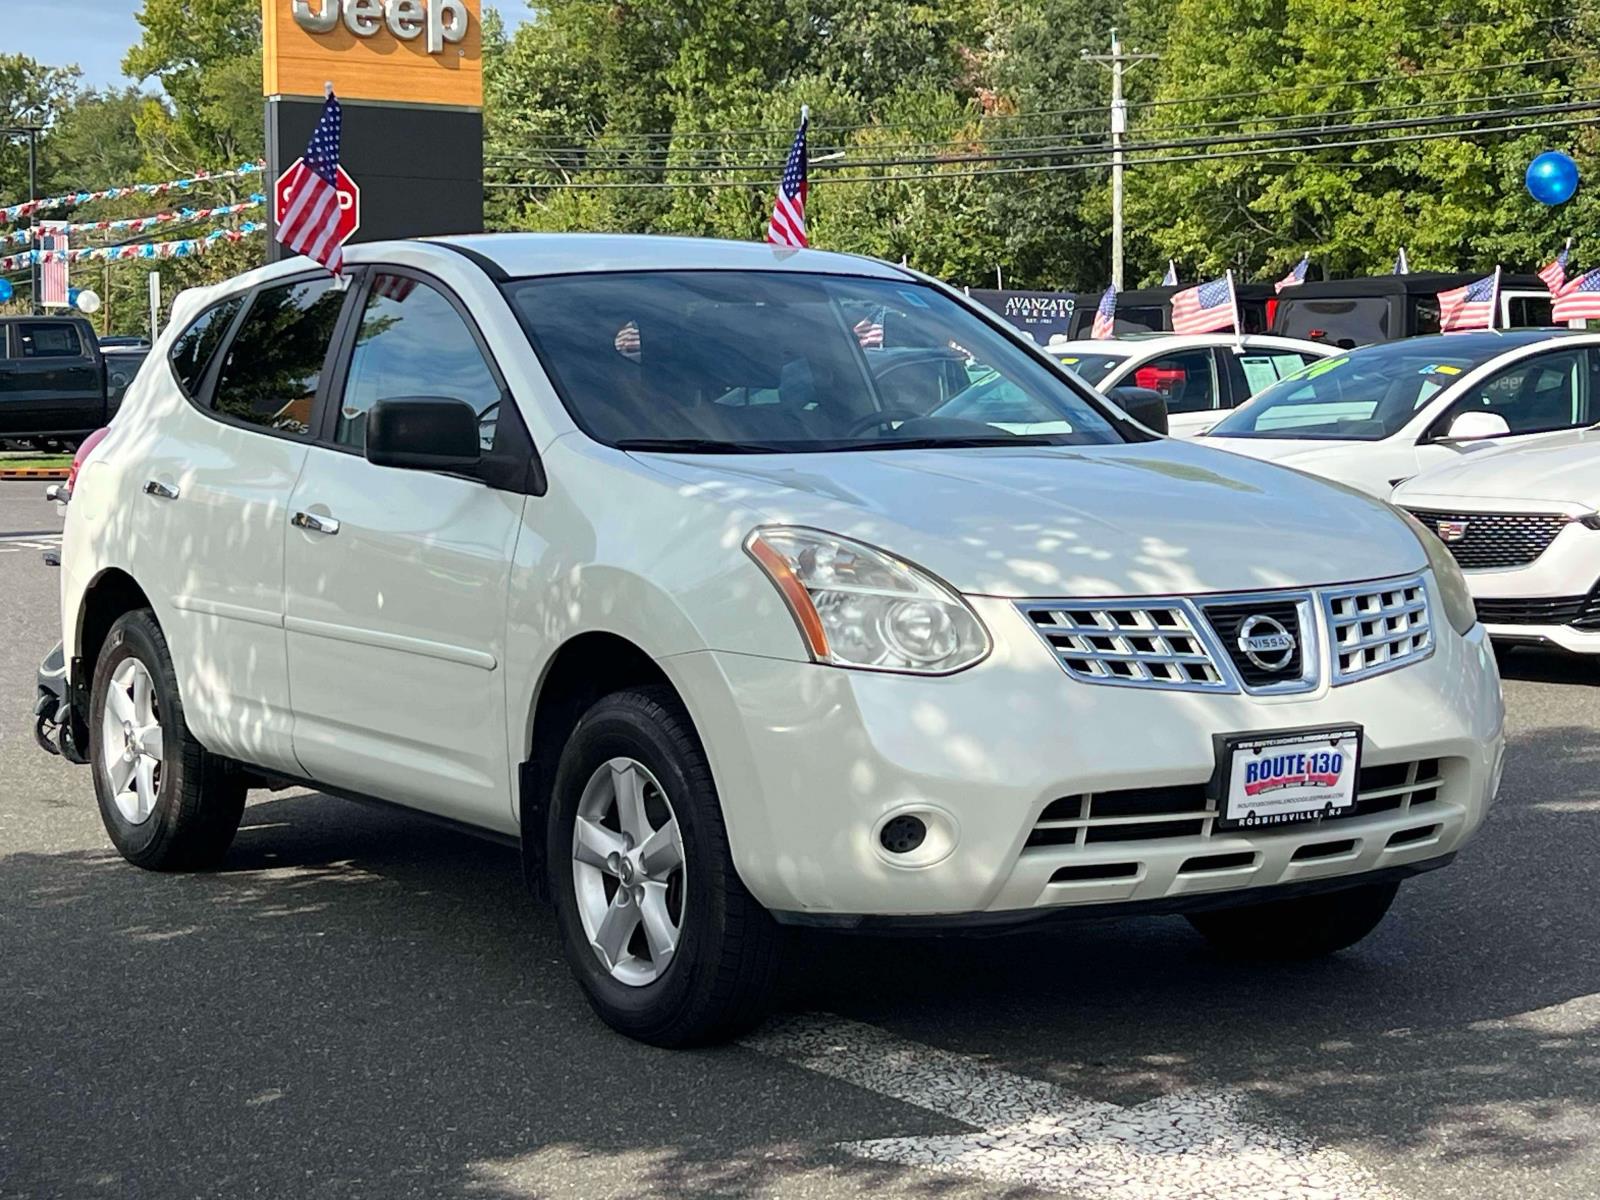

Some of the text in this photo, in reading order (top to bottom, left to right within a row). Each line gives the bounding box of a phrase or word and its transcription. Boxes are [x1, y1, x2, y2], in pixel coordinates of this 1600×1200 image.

[292, 0, 468, 53] Jeep
[1005, 297, 1075, 312] AVANZATO
[1247, 637, 1291, 649] NISSAN
[1246, 753, 1343, 783] ROUTE 130
